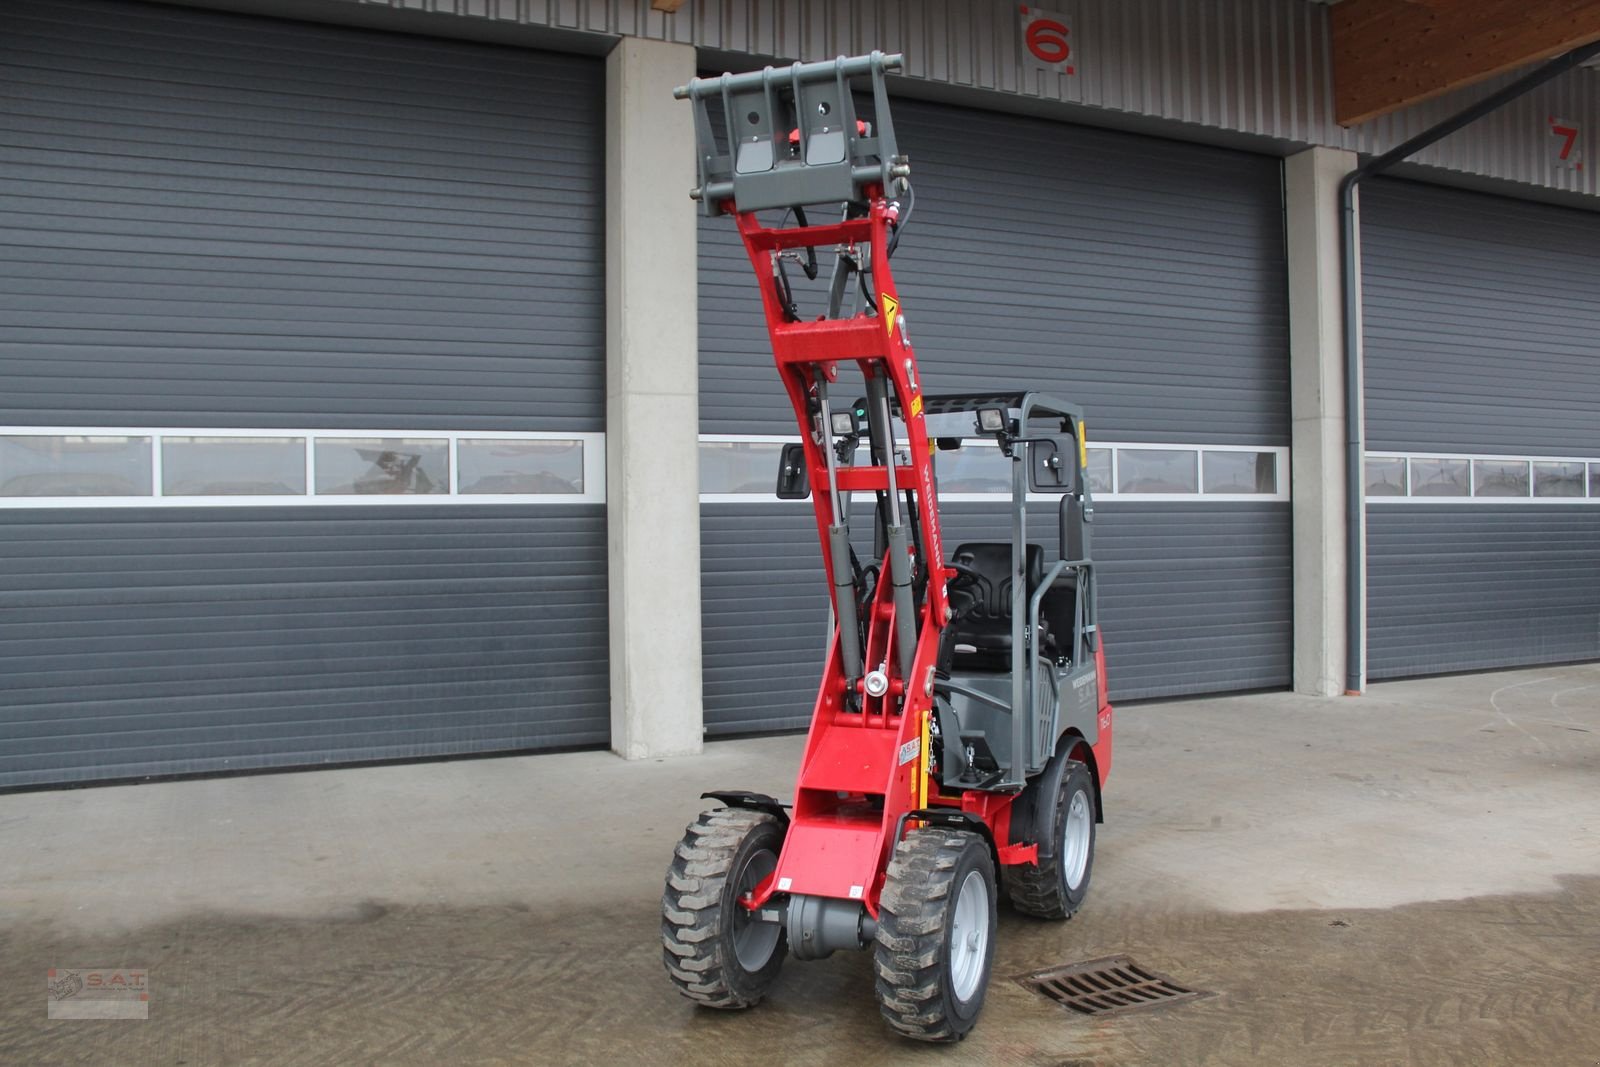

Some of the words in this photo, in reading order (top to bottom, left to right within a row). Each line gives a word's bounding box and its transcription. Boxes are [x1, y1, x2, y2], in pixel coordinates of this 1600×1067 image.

[1025, 18, 1070, 63] 6
[1552, 126, 1577, 160] 7
[924, 464, 942, 570] WEIDEMANN
